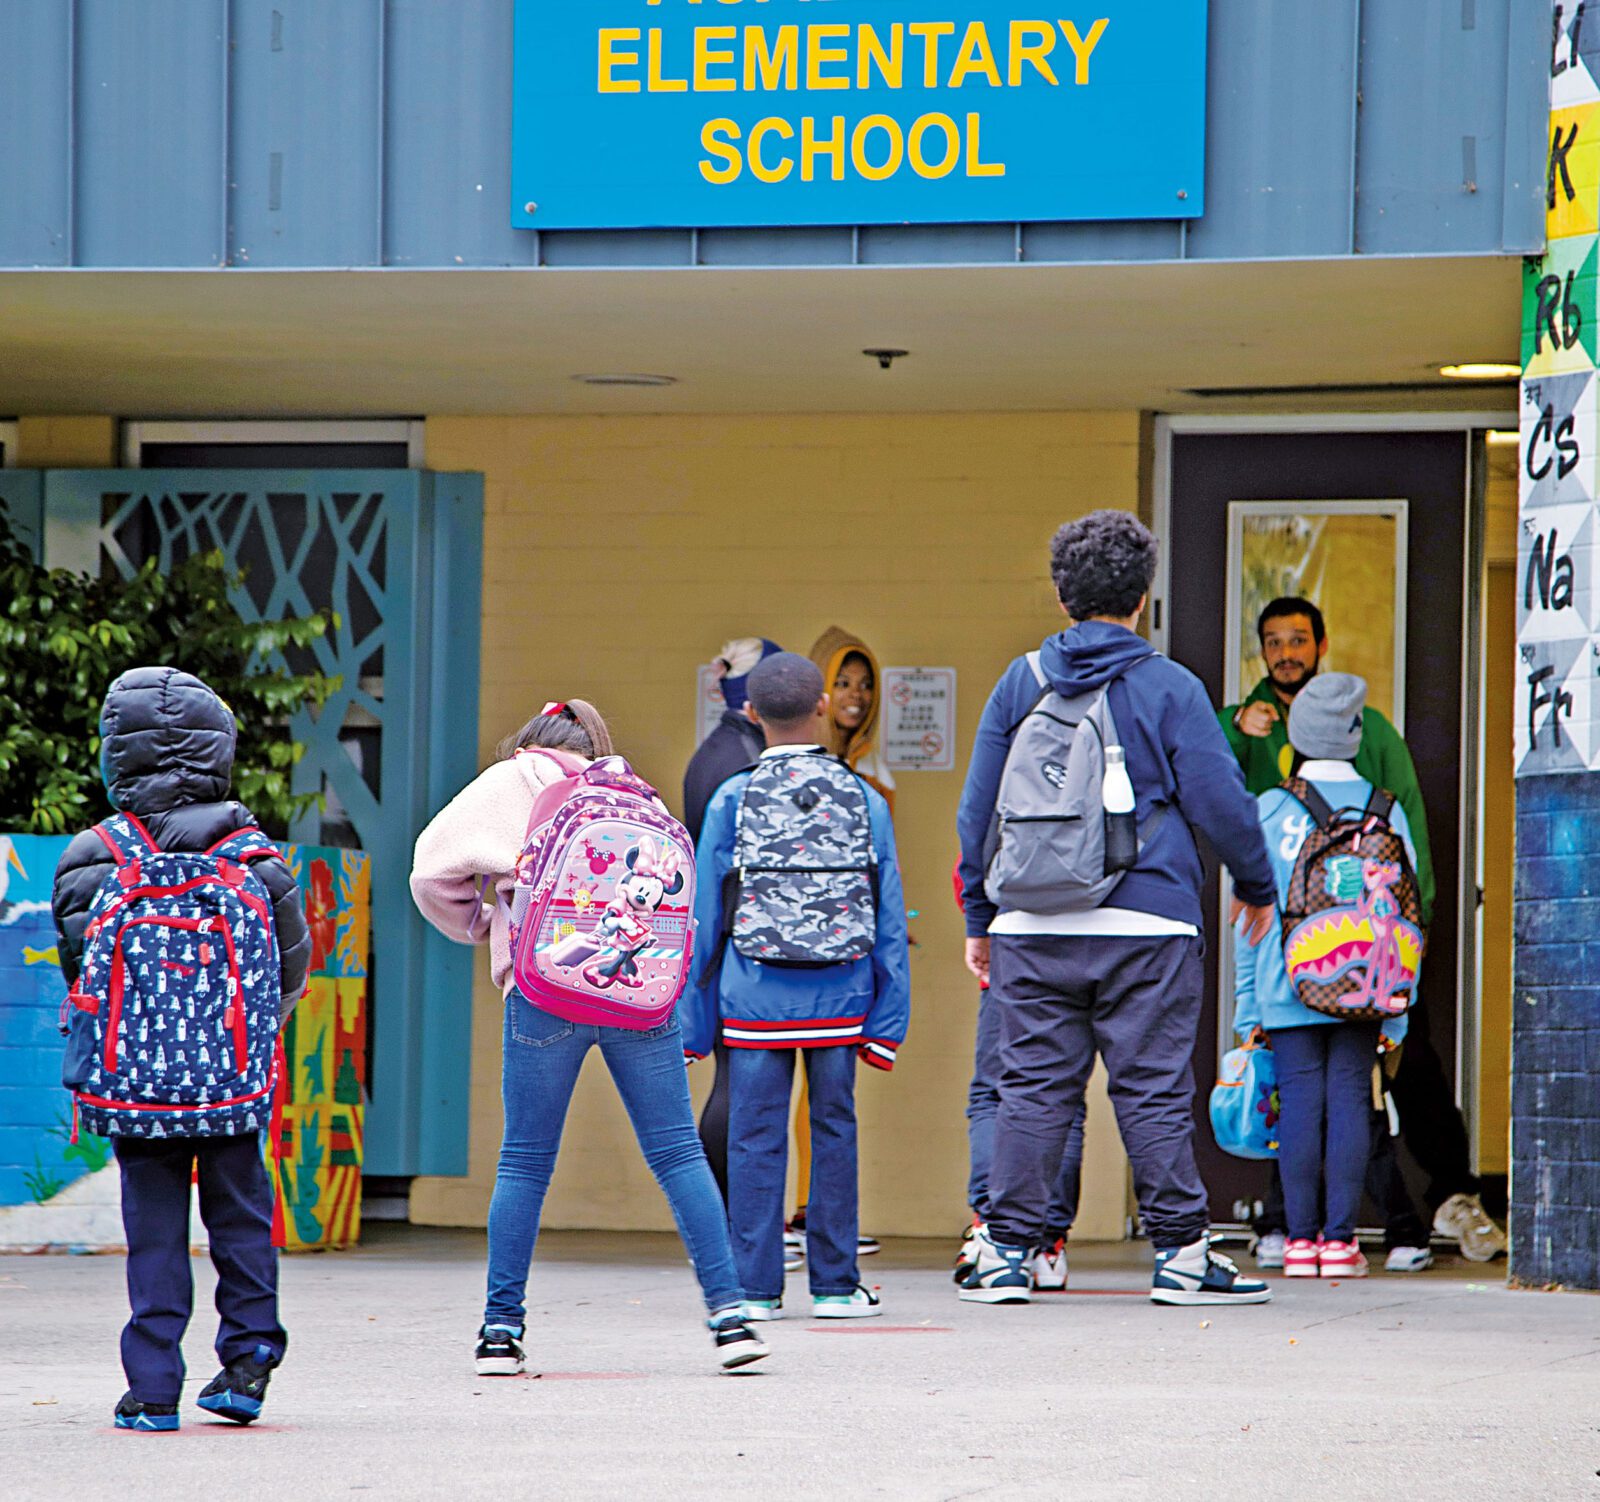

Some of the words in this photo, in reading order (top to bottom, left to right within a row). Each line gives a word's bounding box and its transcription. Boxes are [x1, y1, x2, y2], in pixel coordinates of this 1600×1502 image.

[598, 18, 1110, 93] ELEMENTARY
[699, 112, 1006, 185] SCHOOL
[1548, 122, 1578, 211] K
[1535, 269, 1582, 355] Rb
[1525, 528, 1575, 611] Na
[1528, 665, 1573, 751] Fr
